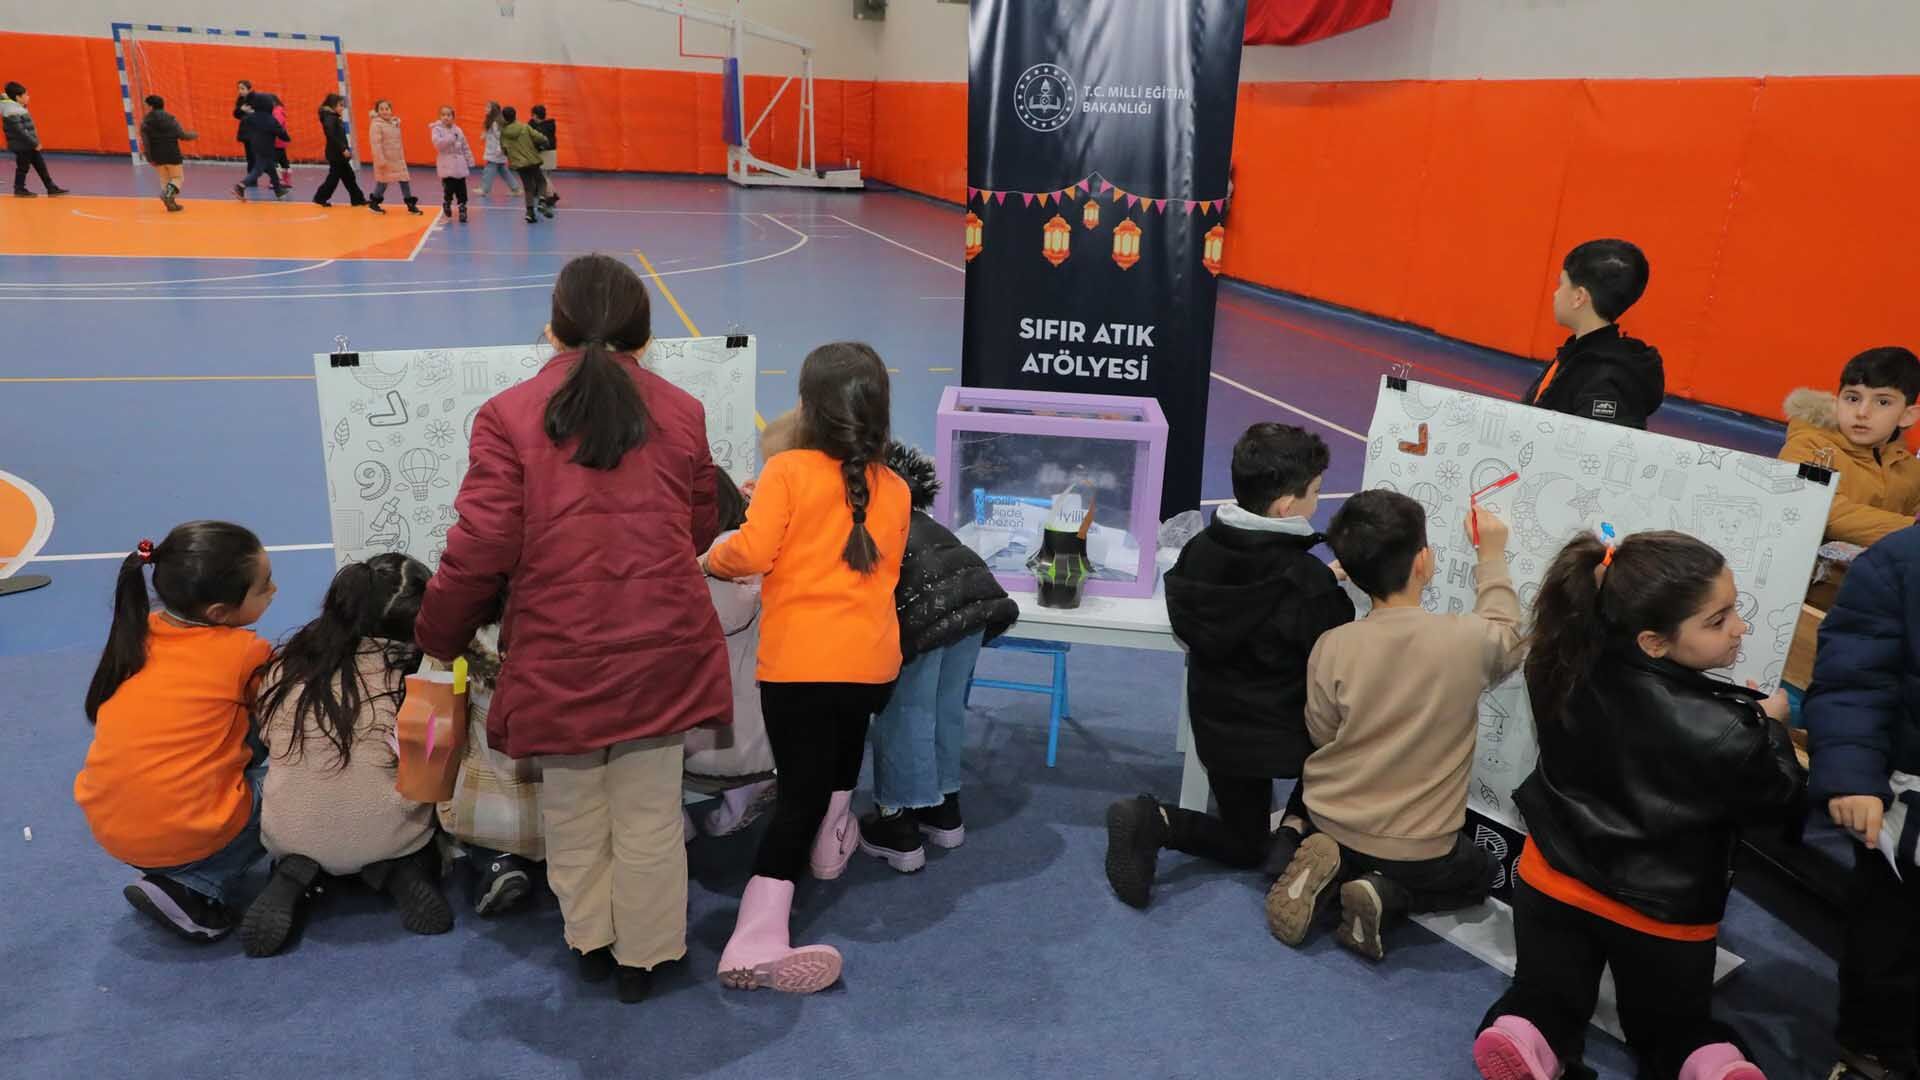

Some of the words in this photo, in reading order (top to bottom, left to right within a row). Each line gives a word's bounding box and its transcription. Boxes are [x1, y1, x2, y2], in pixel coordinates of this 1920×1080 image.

[1082, 85, 1105, 97] T.C.
[1107, 84, 1142, 98] MİLLİ
[1144, 85, 1189, 100] EĞİTİM
[1082, 101, 1152, 114] BAKANLIĞI
[1019, 317, 1086, 343] SIFIR
[1092, 322, 1155, 347] ATIK
[1021, 349, 1149, 381] ATÖLYESİ
